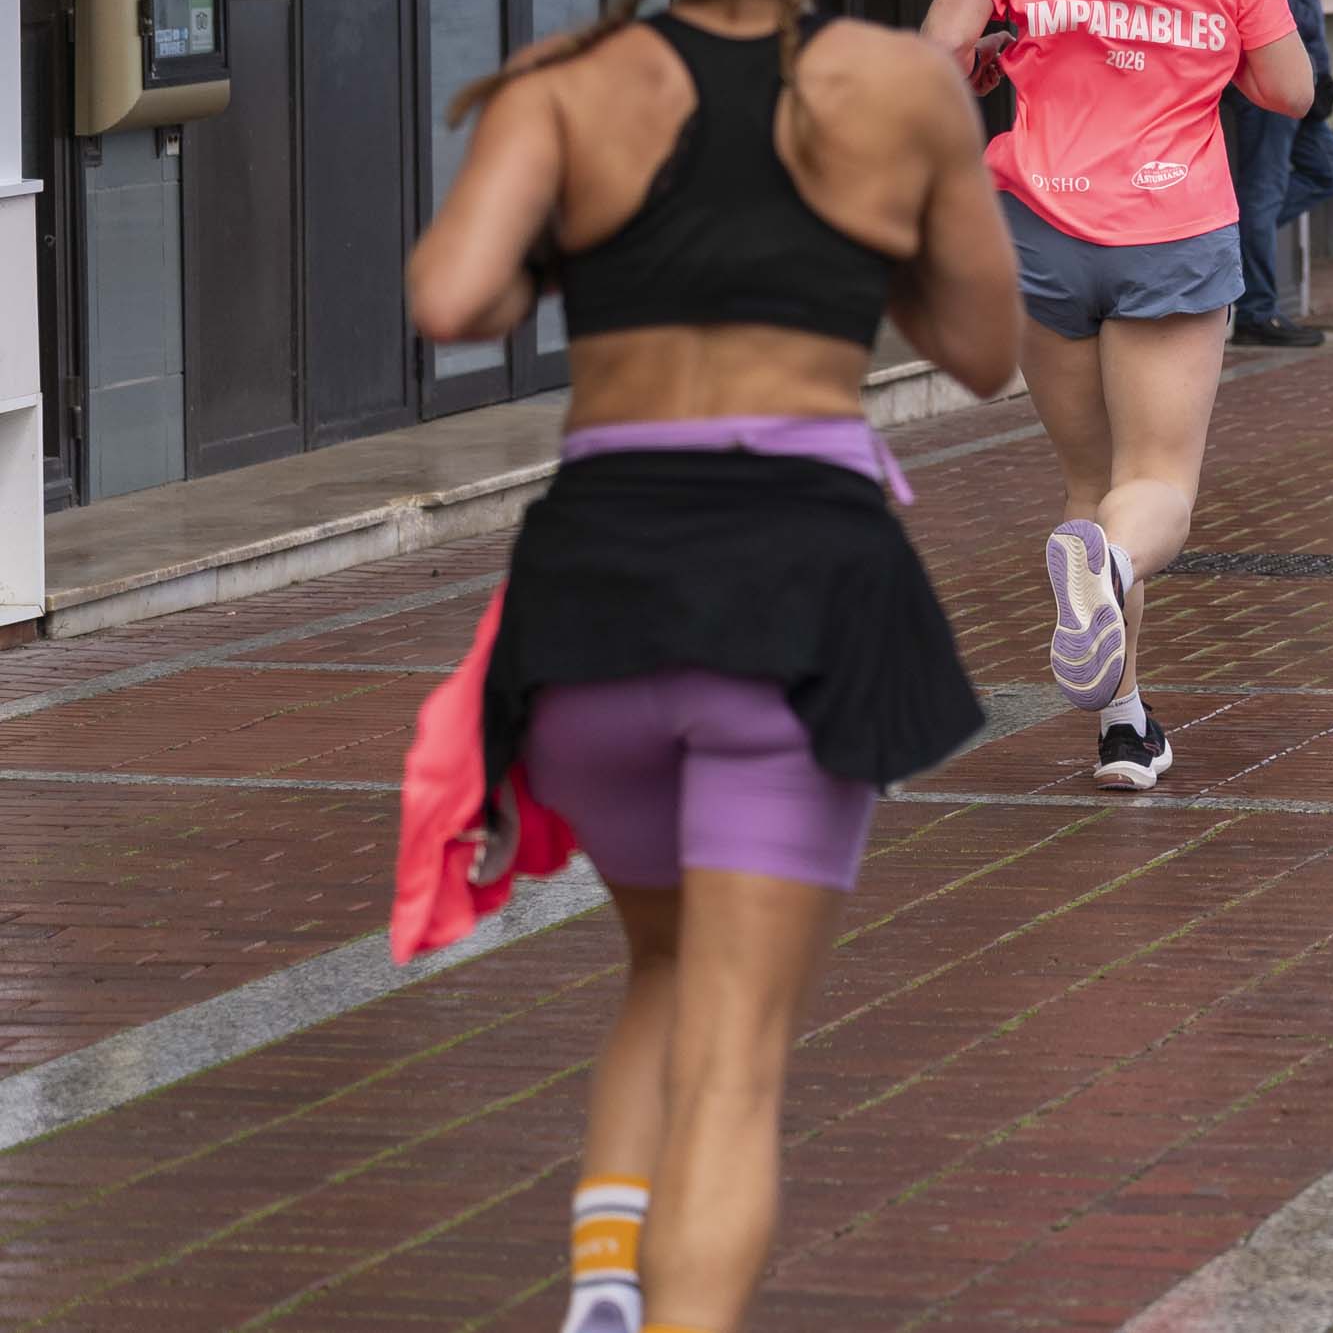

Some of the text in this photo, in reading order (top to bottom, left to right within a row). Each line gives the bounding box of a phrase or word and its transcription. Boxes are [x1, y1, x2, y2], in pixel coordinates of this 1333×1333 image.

[1025, 0, 1227, 52] IMPARABLES
[1105, 49, 1145, 72] 2026
[1032, 174, 1090, 193] OYSHO
